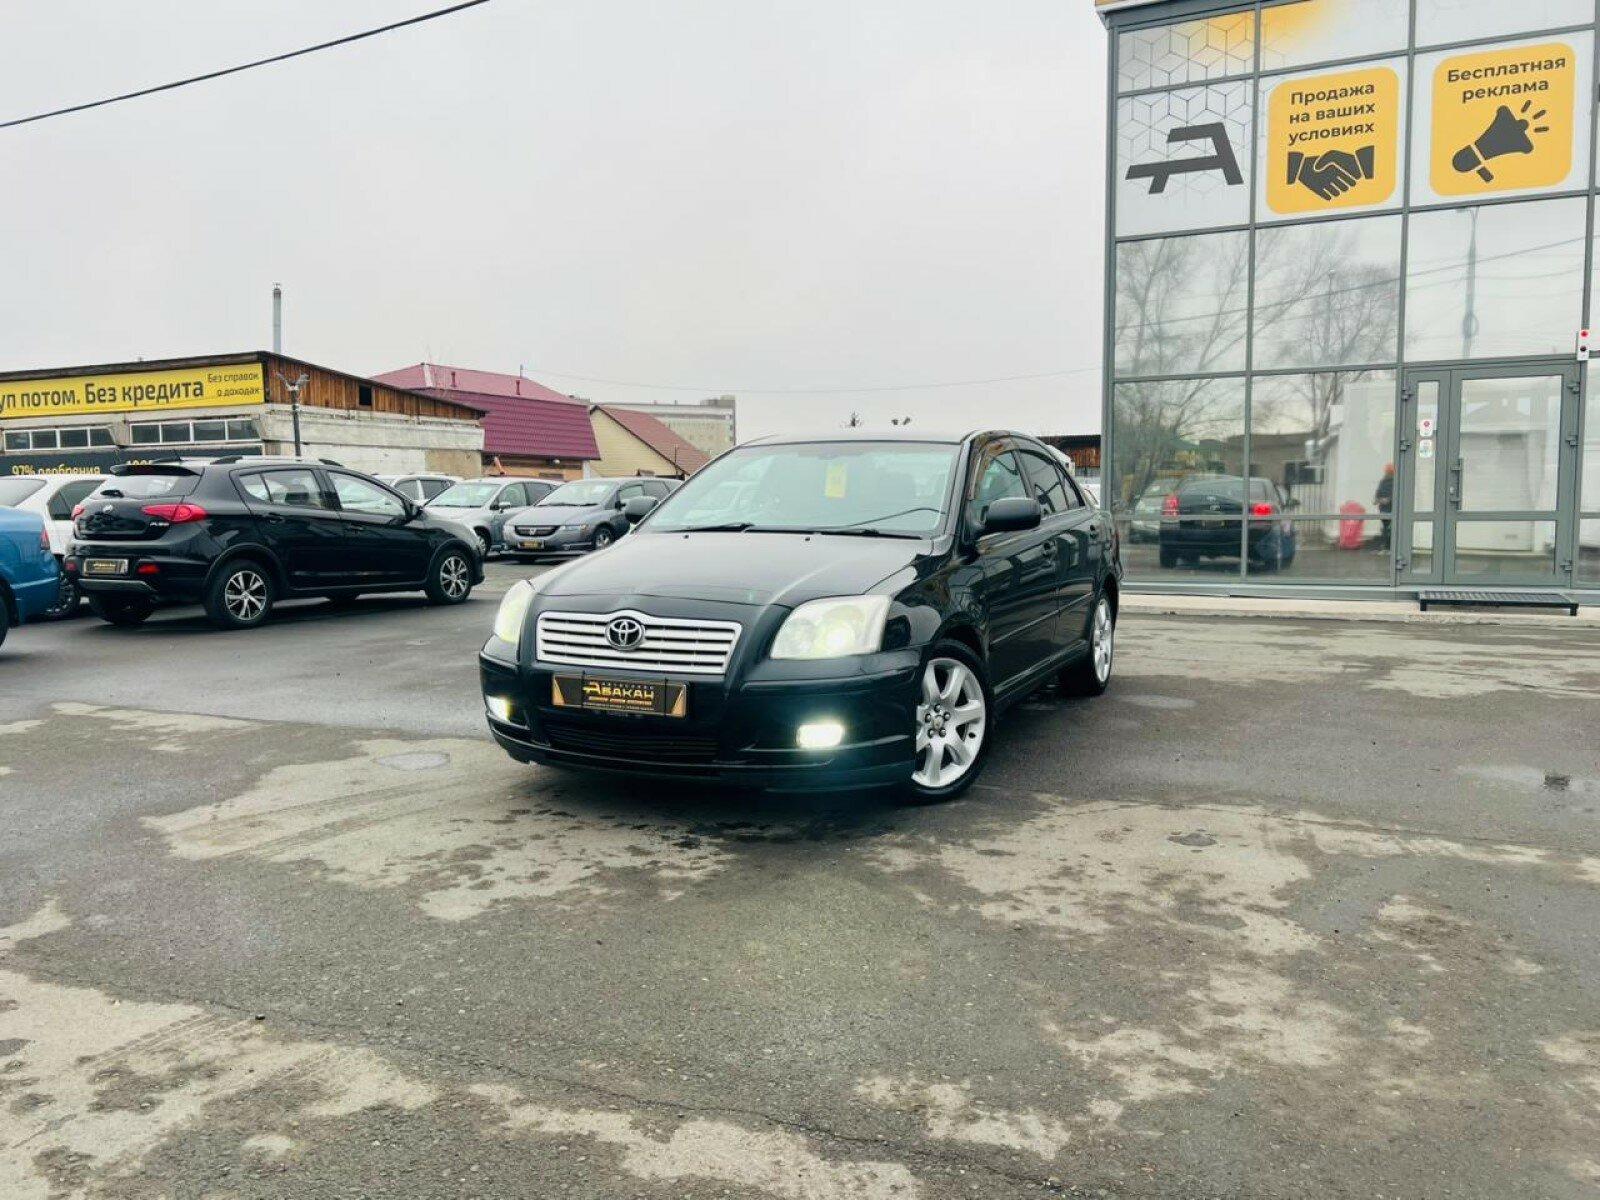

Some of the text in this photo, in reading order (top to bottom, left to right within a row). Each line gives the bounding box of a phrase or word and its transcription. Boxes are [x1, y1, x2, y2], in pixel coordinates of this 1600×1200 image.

[1447, 57, 1567, 83] Бесплатная
[1290, 83, 1376, 106] Продажа
[1461, 79, 1550, 104] реклама
[1289, 102, 1376, 125] на ваших
[1288, 121, 1375, 147] условиях
[20, 389, 81, 409] потом.
[84, 382, 117, 405] Без
[121, 380, 205, 407] кредита
